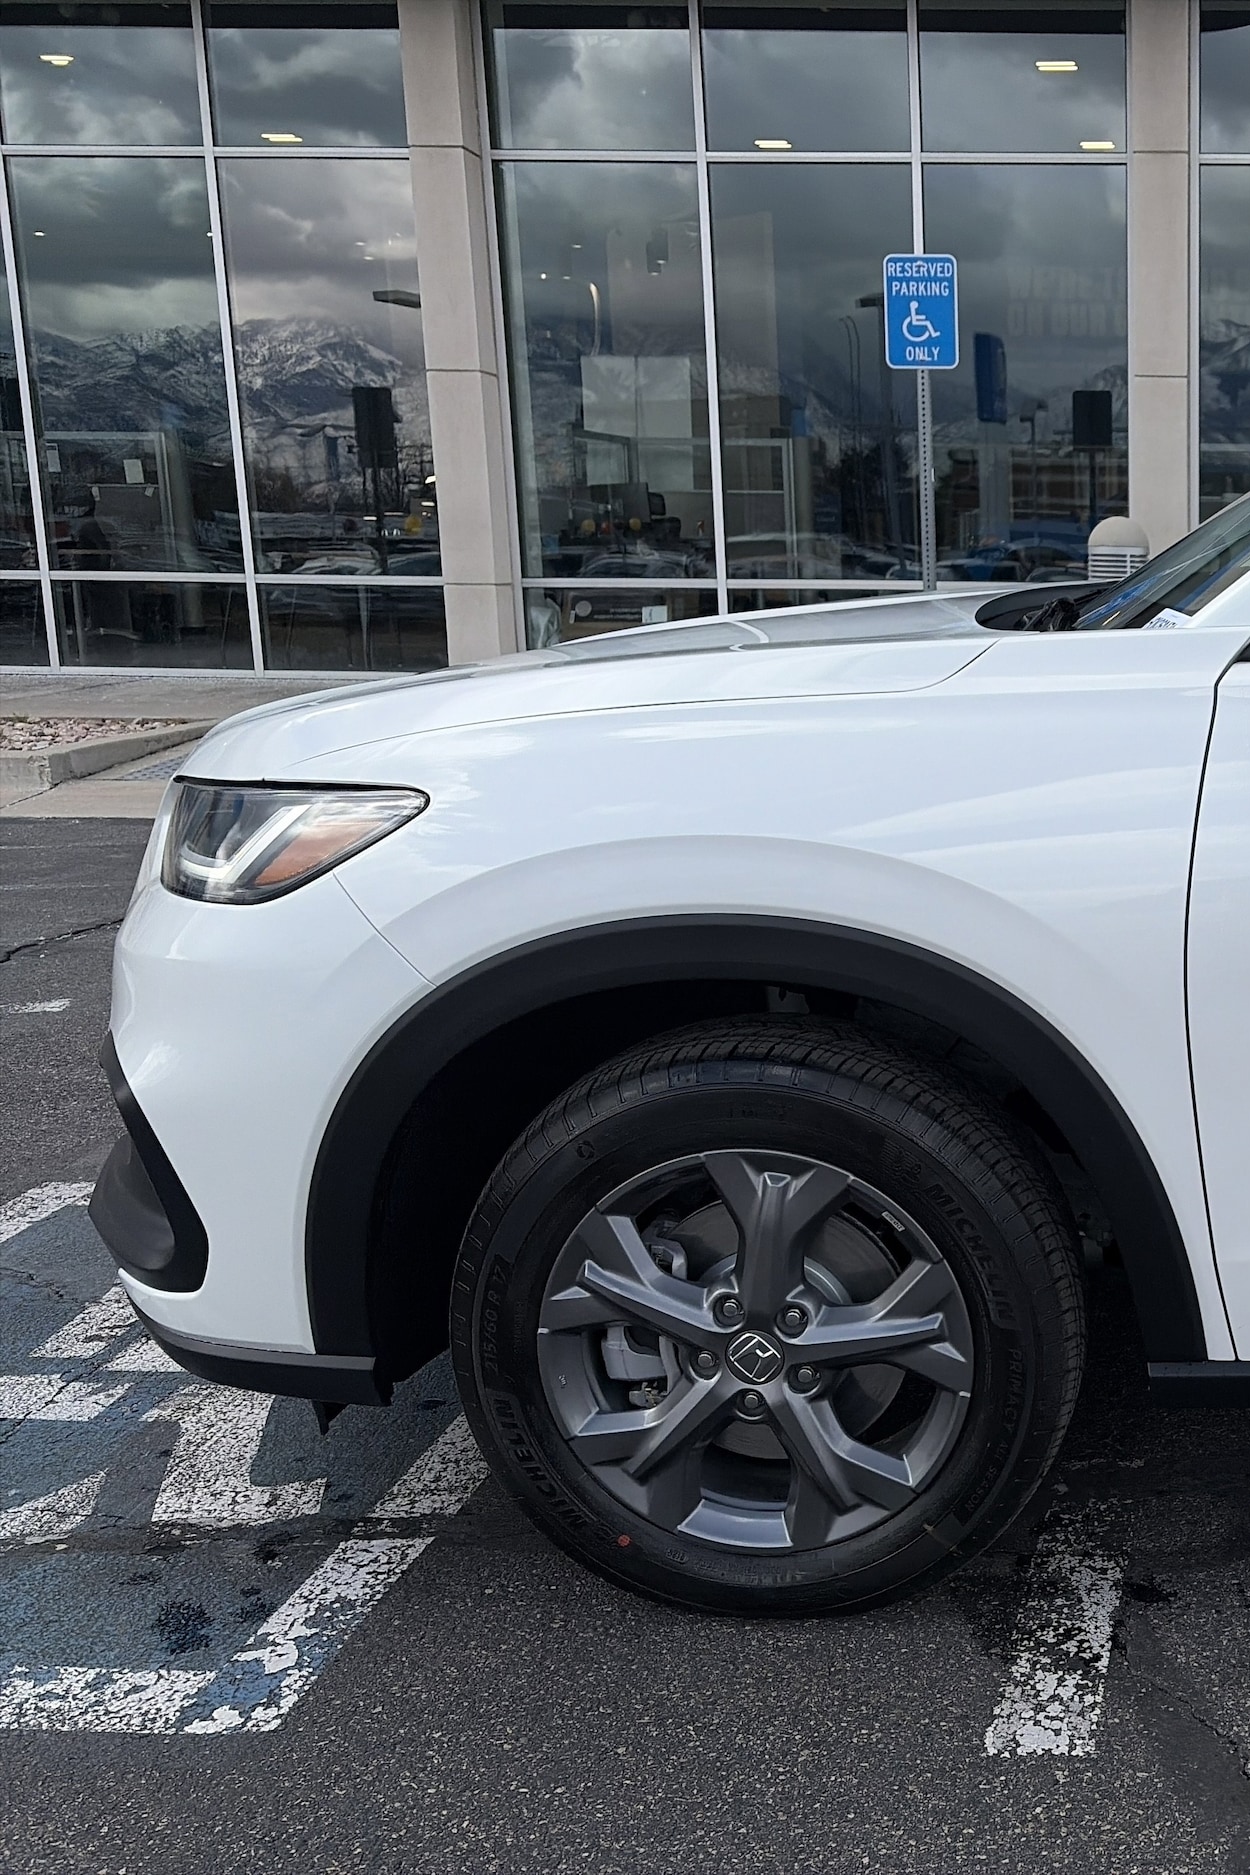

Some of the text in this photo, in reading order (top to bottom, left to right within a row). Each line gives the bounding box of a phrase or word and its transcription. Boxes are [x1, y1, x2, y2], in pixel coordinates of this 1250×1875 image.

[887, 262, 953, 277] RESERVED
[891, 281, 950, 296] PARKING
[905, 346, 940, 361] ONLY
[924, 1183, 1018, 1321] MICHELIN
[1002, 1348, 1024, 1434] PRIMACY
[493, 1398, 594, 1528] MICHELIN
